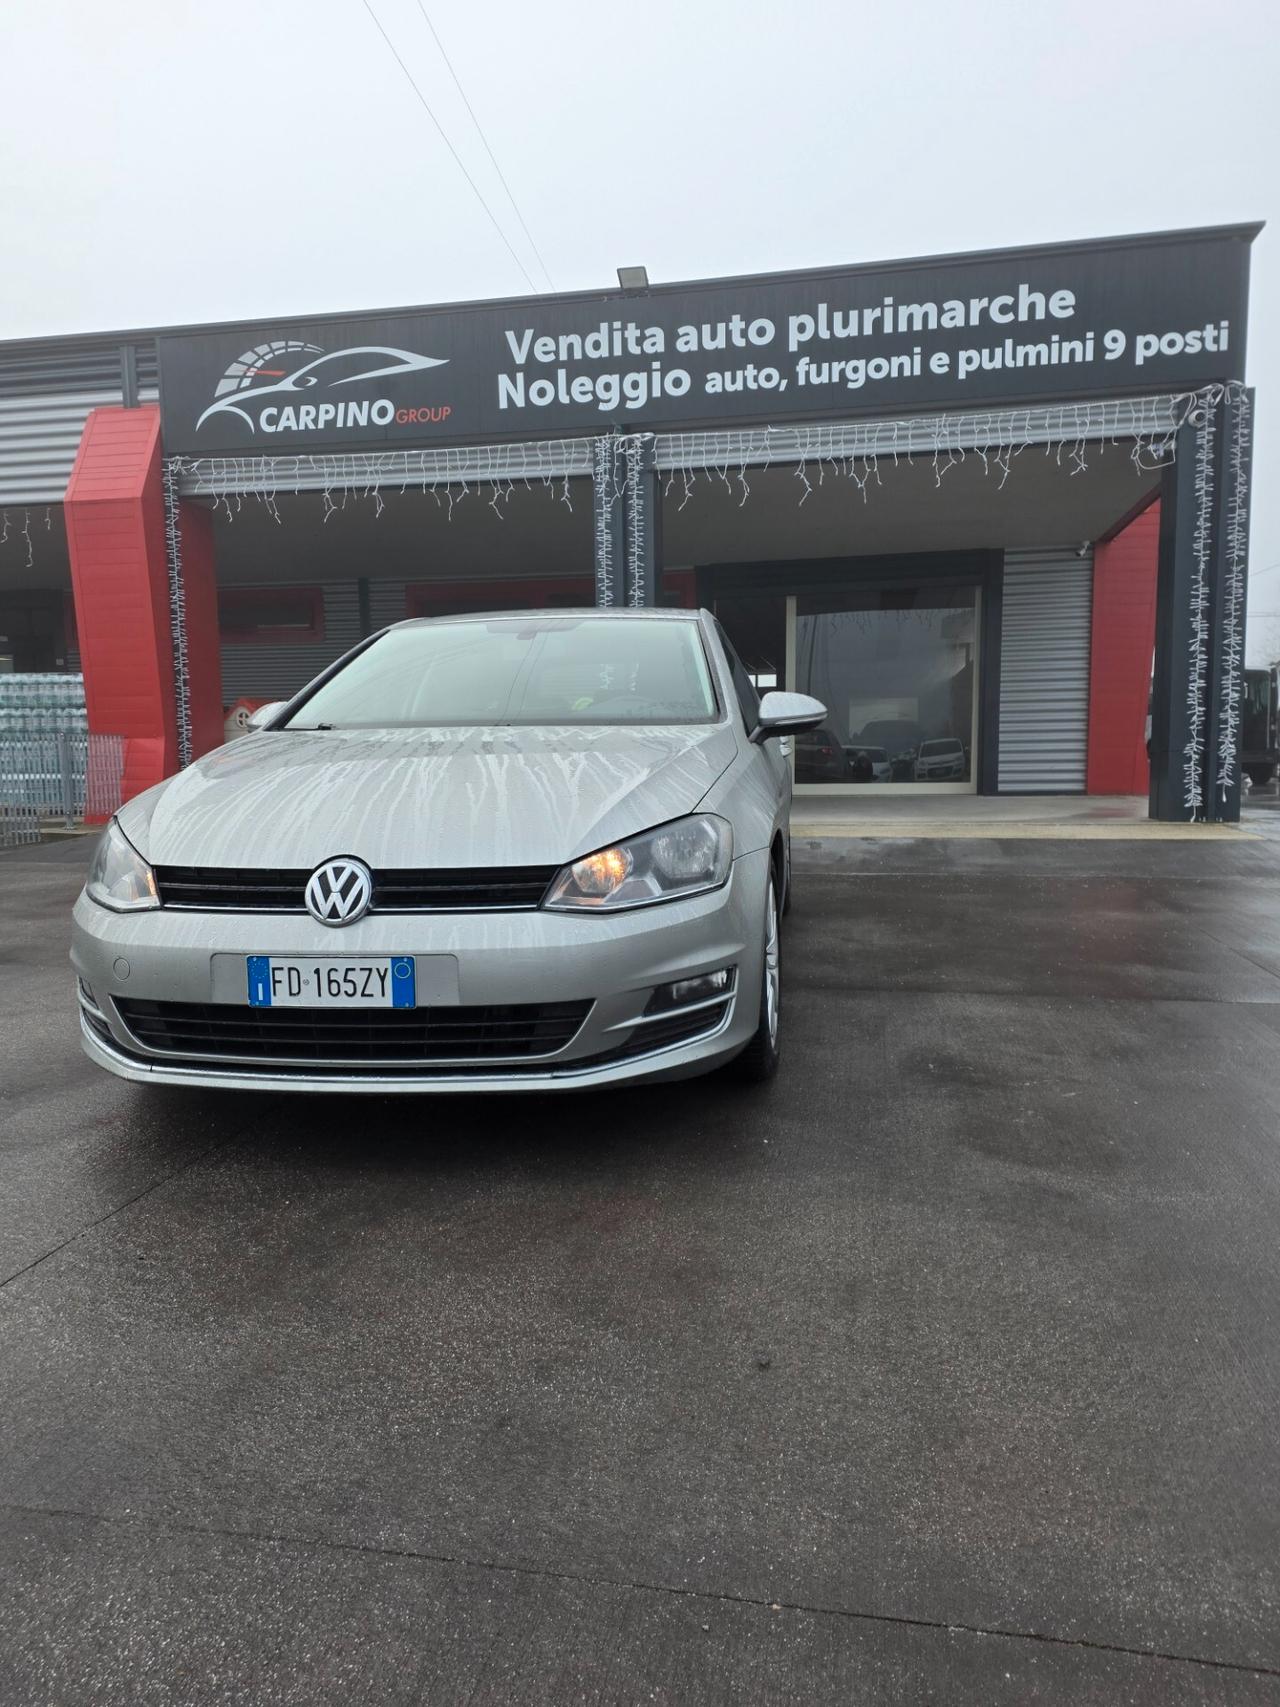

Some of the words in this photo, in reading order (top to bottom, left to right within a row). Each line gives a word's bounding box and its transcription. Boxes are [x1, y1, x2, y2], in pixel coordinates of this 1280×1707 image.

[504, 320, 664, 365] Vendita
[675, 315, 776, 354] auto
[788, 283, 1076, 352] plurimarche
[497, 361, 692, 411] Noleggio
[704, 363, 788, 393] auto,
[796, 346, 922, 389] furgoni
[929, 351, 950, 374] e
[958, 334, 1095, 380] pulmini
[1103, 329, 1126, 360] 9
[1136, 320, 1229, 366] posti
[258, 398, 395, 433] CARPINO
[395, 406, 452, 426] GROUP
